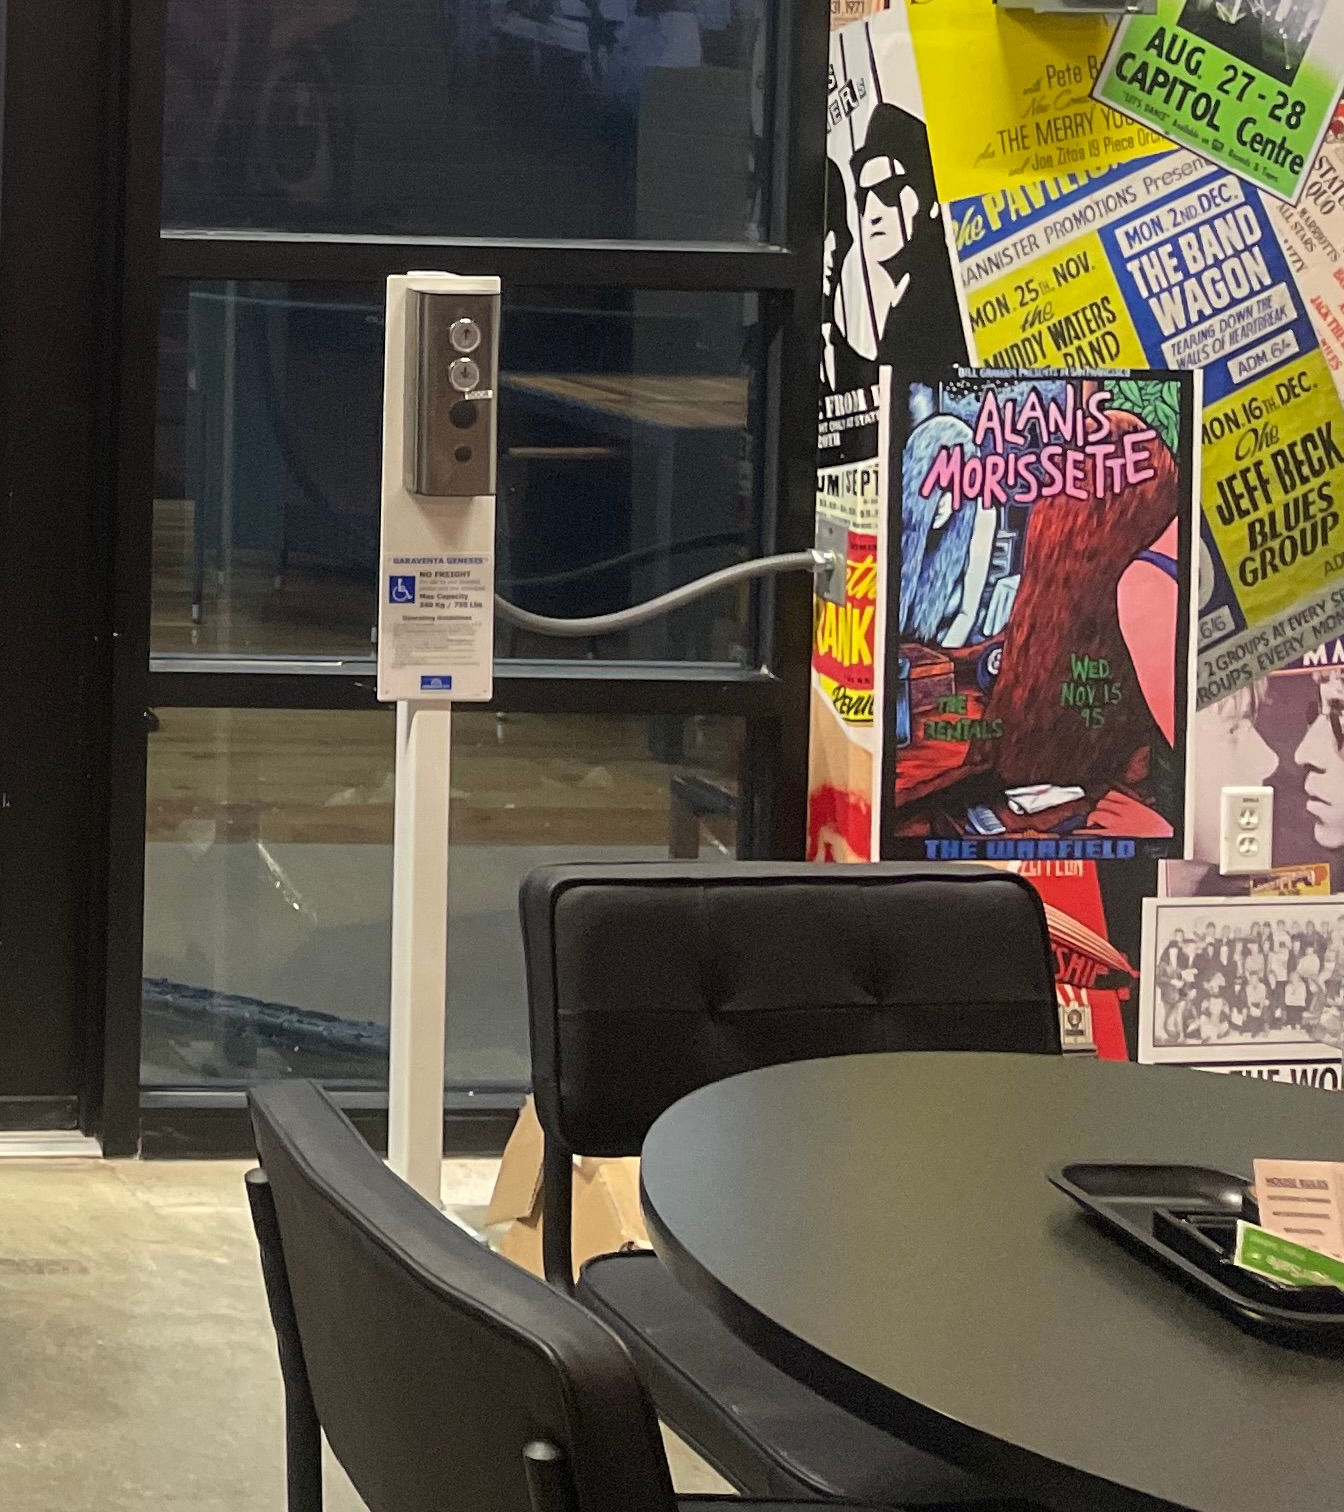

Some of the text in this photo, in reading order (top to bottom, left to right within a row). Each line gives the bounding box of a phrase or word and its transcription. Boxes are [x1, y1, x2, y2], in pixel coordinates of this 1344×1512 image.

[1115, 52, 1304, 175] CAPITOL Centre
[1145, 27, 1308, 131] AUG. 27 28
[1044, 187, 1137, 241] PROMOTIONS
[1126, 205, 1263, 300] THE BAND
[1148, 252, 1274, 337] WAGON
[1169, 294, 1274, 359] TEARING DOWN THE
[1211, 307, 1288, 362] OF HEARTBREAK
[975, 385, 1112, 452] ALANIS
[919, 430, 1157, 511] MORISSETTE
[1216, 423, 1344, 527] JEFF BECK
[1239, 517, 1340, 589] GROUP
[1248, 479, 1334, 555] BLUES
[923, 837, 1136, 860] THE WARFIELD
